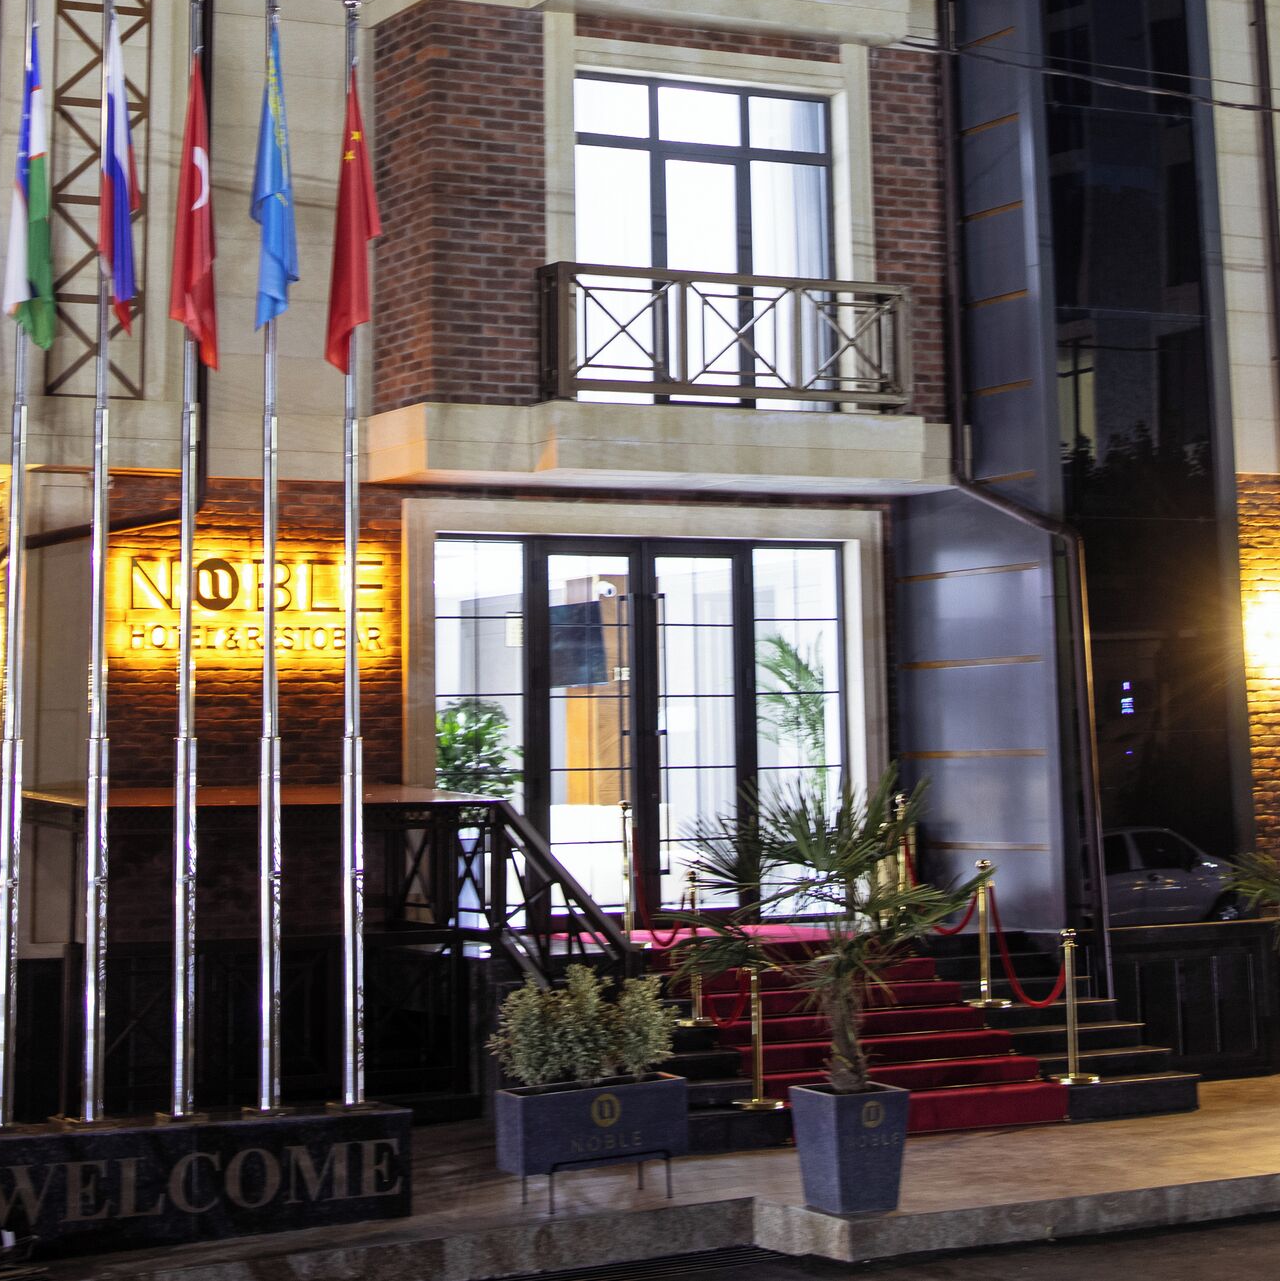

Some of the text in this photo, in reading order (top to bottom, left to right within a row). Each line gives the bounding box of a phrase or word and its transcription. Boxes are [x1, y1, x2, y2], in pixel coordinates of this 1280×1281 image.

[131, 557, 384, 612] NOBLE
[223, 626, 240, 651] &
[246, 626, 384, 651] RSTOBR
